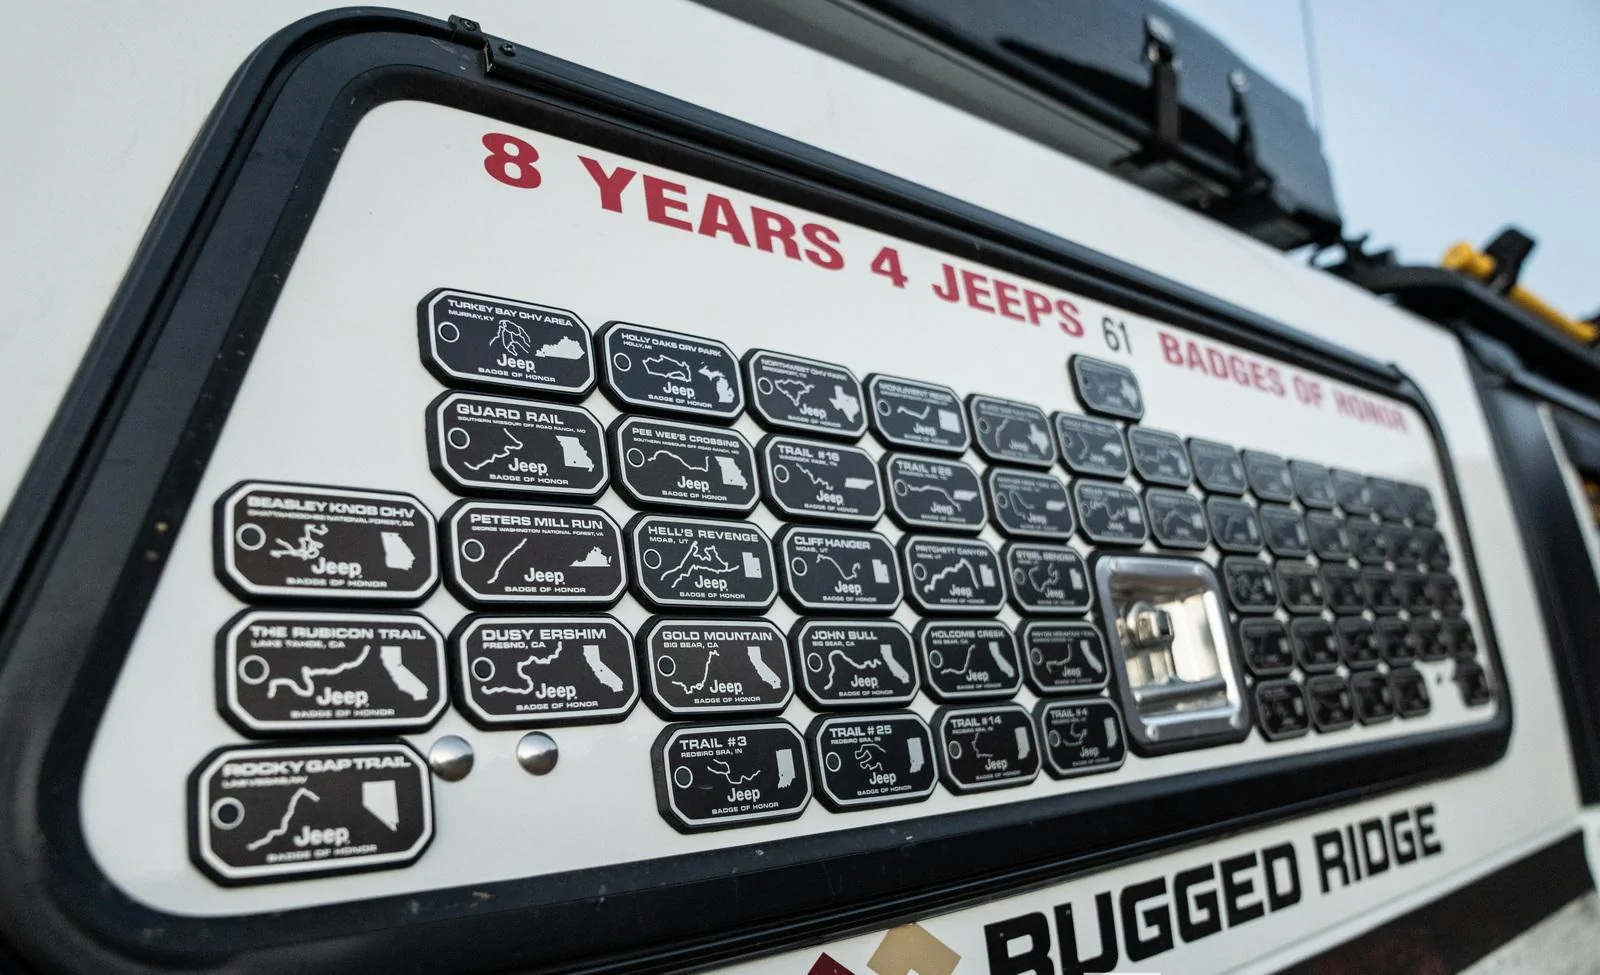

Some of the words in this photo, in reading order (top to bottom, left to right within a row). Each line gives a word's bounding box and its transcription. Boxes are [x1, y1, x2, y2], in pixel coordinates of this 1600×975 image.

[482, 132, 542, 189] 8
[577, 154, 845, 271] YEARS
[869, 246, 909, 290] 4
[932, 263, 1086, 339] JEEPS
[1101, 314, 1133, 357] 61
[1157, 331, 1287, 398] BADGES
[1292, 374, 1327, 408] OF
[1333, 388, 1410, 434] HONOR
[448, 300, 493, 313] TURKEY
[495, 308, 517, 317] BAY
[519, 311, 542, 321] OHV
[544, 316, 573, 327] AREA
[622, 333, 650, 344] HOLLY
[652, 339, 677, 349] OAKS
[698, 348, 721, 357] PARK
[497, 353, 535, 372] Jeep
[479, 367, 509, 376] BADGE
[526, 373, 555, 382] HONOR
[663, 382, 695, 398] Jeep
[648, 394, 674, 402] BADGE
[457, 404, 520, 419] GUARD
[526, 412, 563, 424] RAIL
[800, 403, 826, 420] Jeep
[632, 428, 652, 436] PEE
[655, 430, 686, 440] WEE'S
[689, 435, 739, 448] CROSSING
[777, 445, 813, 457] TRAIL
[508, 458, 547, 476] Jeep
[678, 476, 710, 492] Jeep
[816, 490, 843, 505] Jeep
[247, 496, 327, 512] BEASLEY
[329, 502, 378, 516] KNOB
[380, 507, 415, 518] OHV
[470, 514, 531, 525] PETERS
[535, 518, 568, 527] MILL
[572, 520, 603, 529] RUN
[648, 526, 693, 537] HELL'S
[698, 530, 758, 542] REVENGE
[794, 536, 823, 546] CLIFF
[825, 539, 870, 550] HANGER
[311, 557, 361, 578] Jeep
[286, 577, 326, 586] BADGE
[524, 568, 564, 585] Jeep
[695, 575, 727, 591] Jeep
[835, 580, 861, 595] Jeep
[250, 626, 288, 639] THE
[292, 627, 374, 639] RUBICON
[378, 629, 426, 640] TRAIL
[481, 630, 533, 641] DUSY
[540, 629, 606, 639] ERSHIM
[662, 632, 699, 640] GOLD
[704, 632, 772, 640] MOUNTAIN
[812, 631, 845, 640] JOHN
[848, 631, 877, 640] BULL
[251, 640, 282, 648] LAKE
[710, 680, 742, 695] Jeep
[851, 675, 878, 688] Jeep
[316, 687, 368, 708] Jeep
[536, 683, 576, 700] Jeep
[290, 710, 332, 719] BADGE
[335, 709, 350, 717] OF
[354, 708, 394, 717] HONOR
[950, 718, 980, 728] TRAIL
[829, 727, 865, 738] TRAIL
[679, 738, 722, 750] TRAIL
[727, 736, 747, 746] #3
[222, 761, 305, 777] ROCKY
[306, 759, 352, 773] GAP
[353, 757, 411, 770] TRAIL
[985, 759, 1008, 770] Jeep
[869, 772, 896, 785] Jeep
[727, 788, 760, 802] Jeep
[712, 807, 738, 815] BADGE
[294, 826, 349, 846] Jeep
[983, 841, 1304, 975] RUGGED
[1313, 804, 1443, 895] RIDGE
